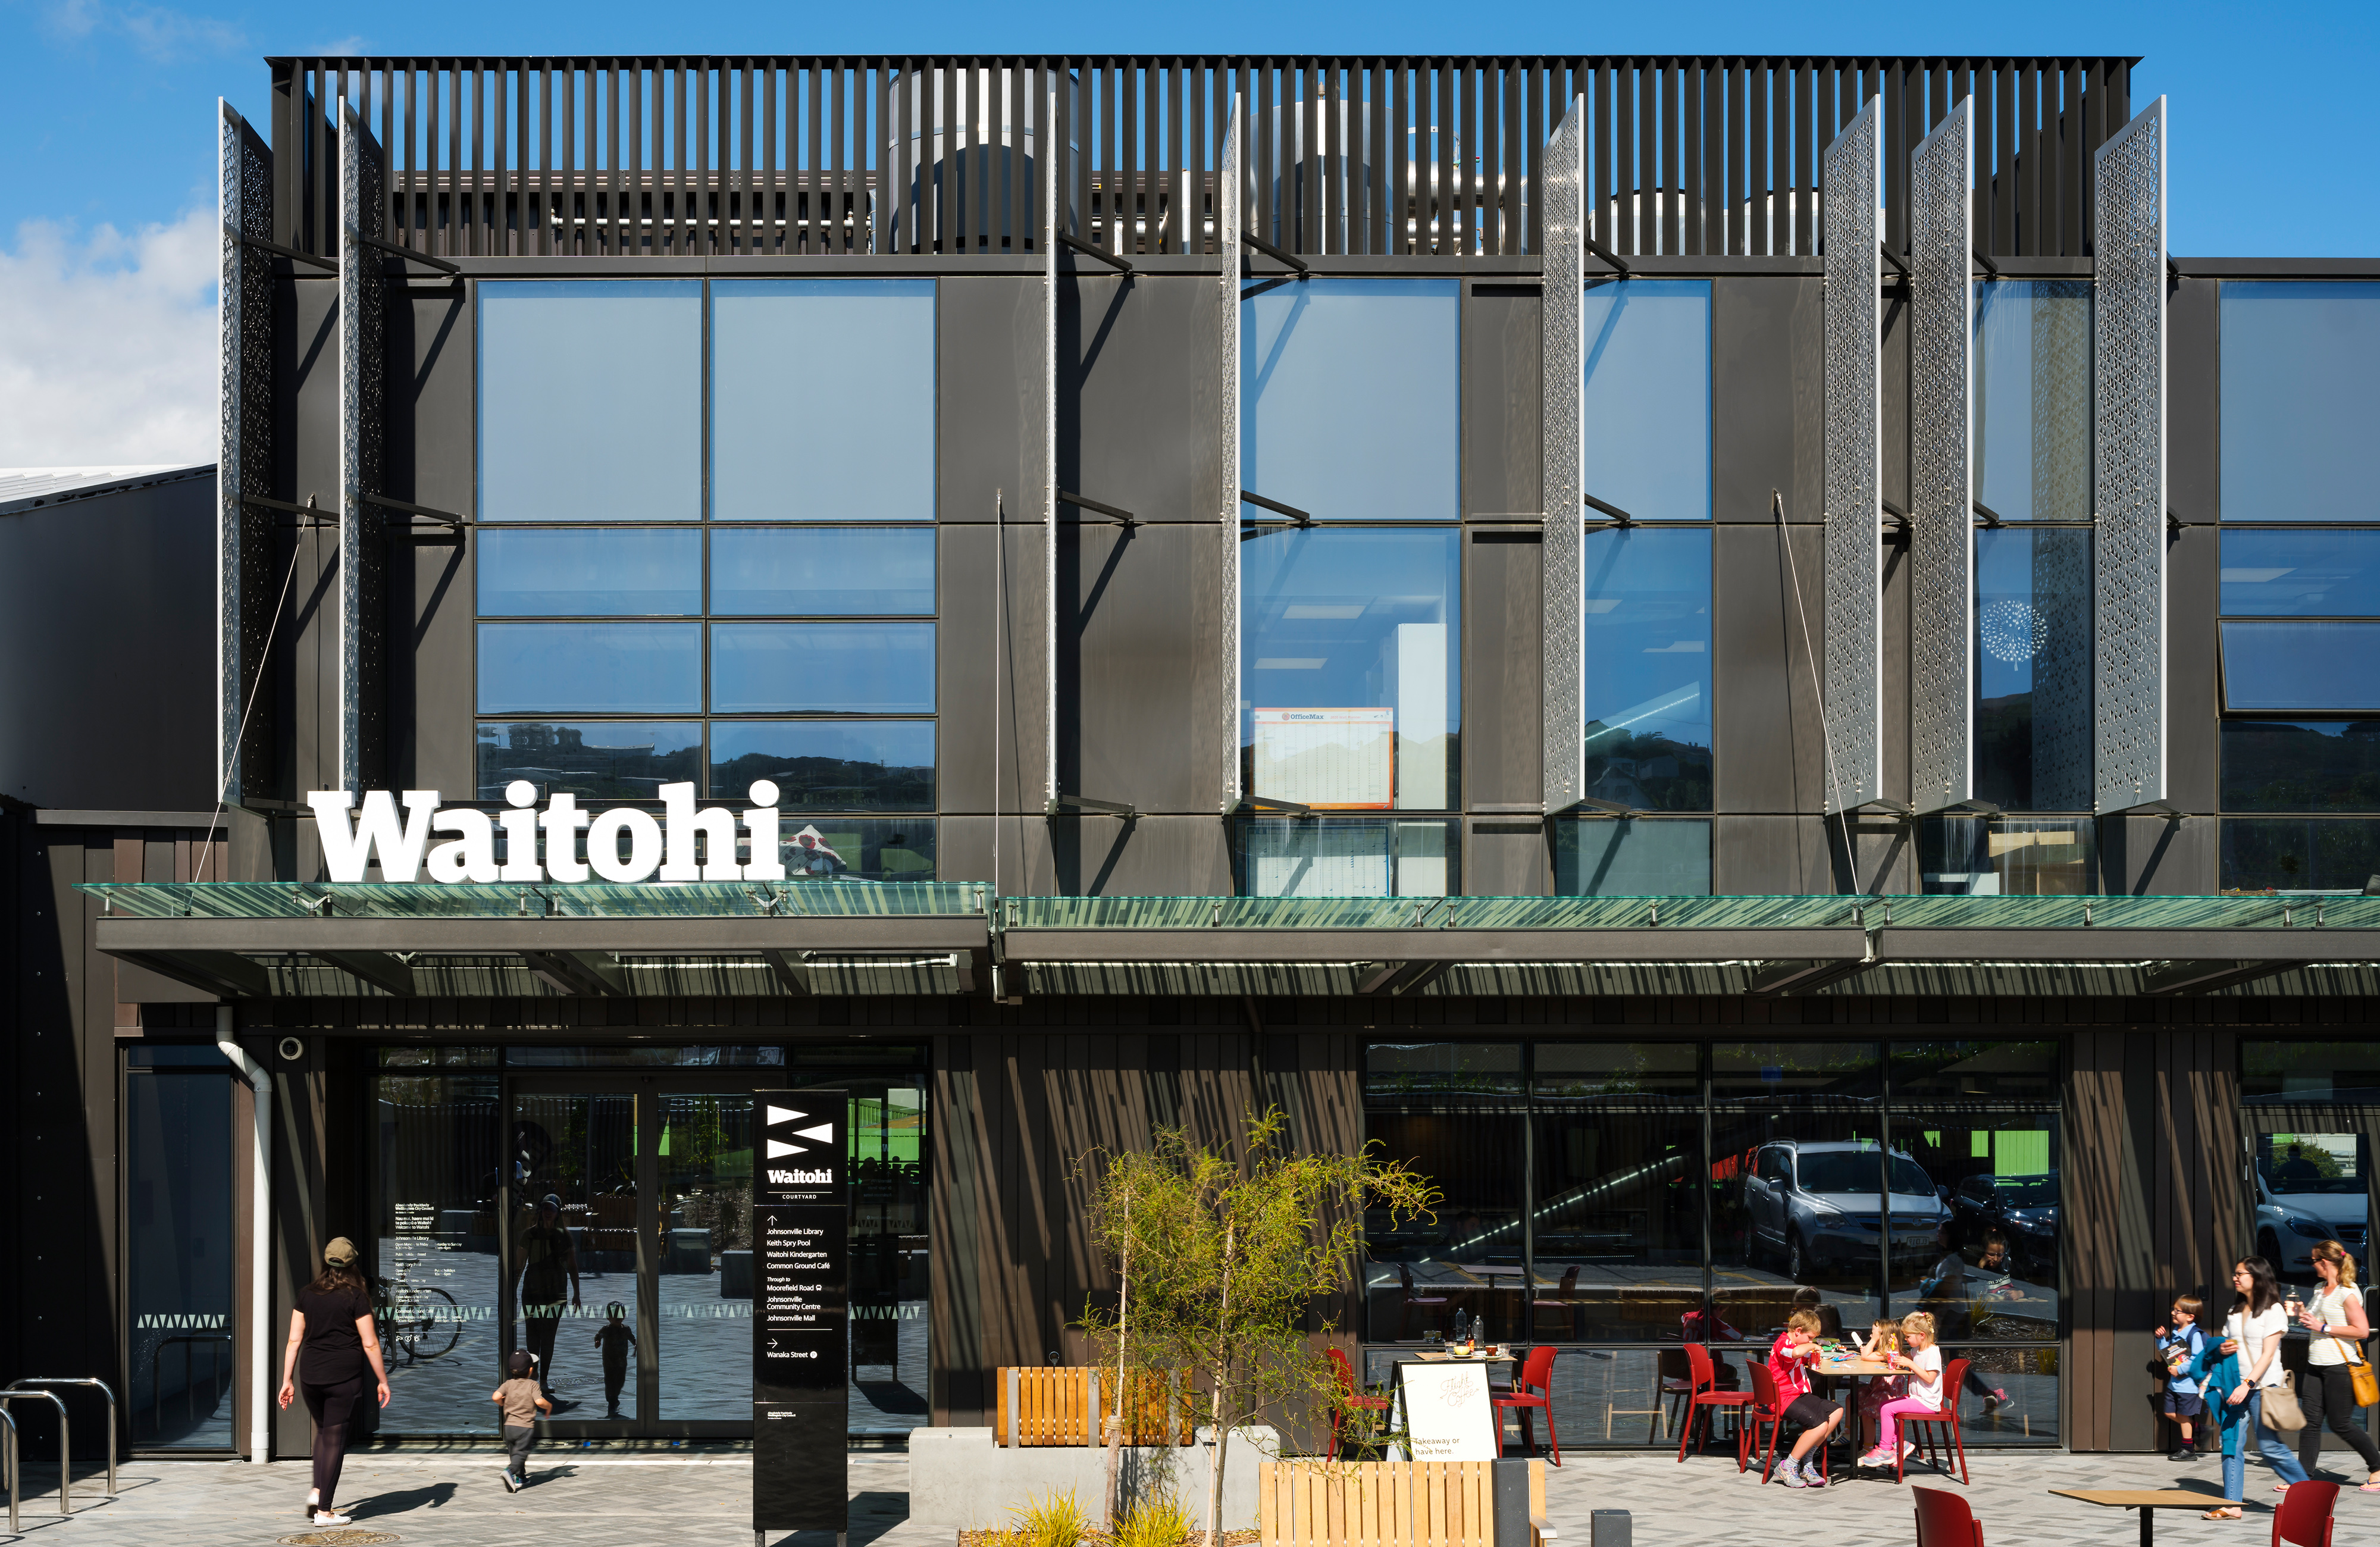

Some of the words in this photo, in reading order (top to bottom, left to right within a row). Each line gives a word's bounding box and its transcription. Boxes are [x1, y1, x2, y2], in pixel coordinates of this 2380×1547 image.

[308, 780, 785, 884] Waitohi
[767, 1168, 833, 1184] Waitohi
[782, 1239, 797, 1248] Spry
[790, 1251, 827, 1259] Kindergarten
[766, 1303, 801, 1311] Community
[1440, 1371, 1473, 1398] Flight
[1447, 1385, 1479, 1407] Coffee
